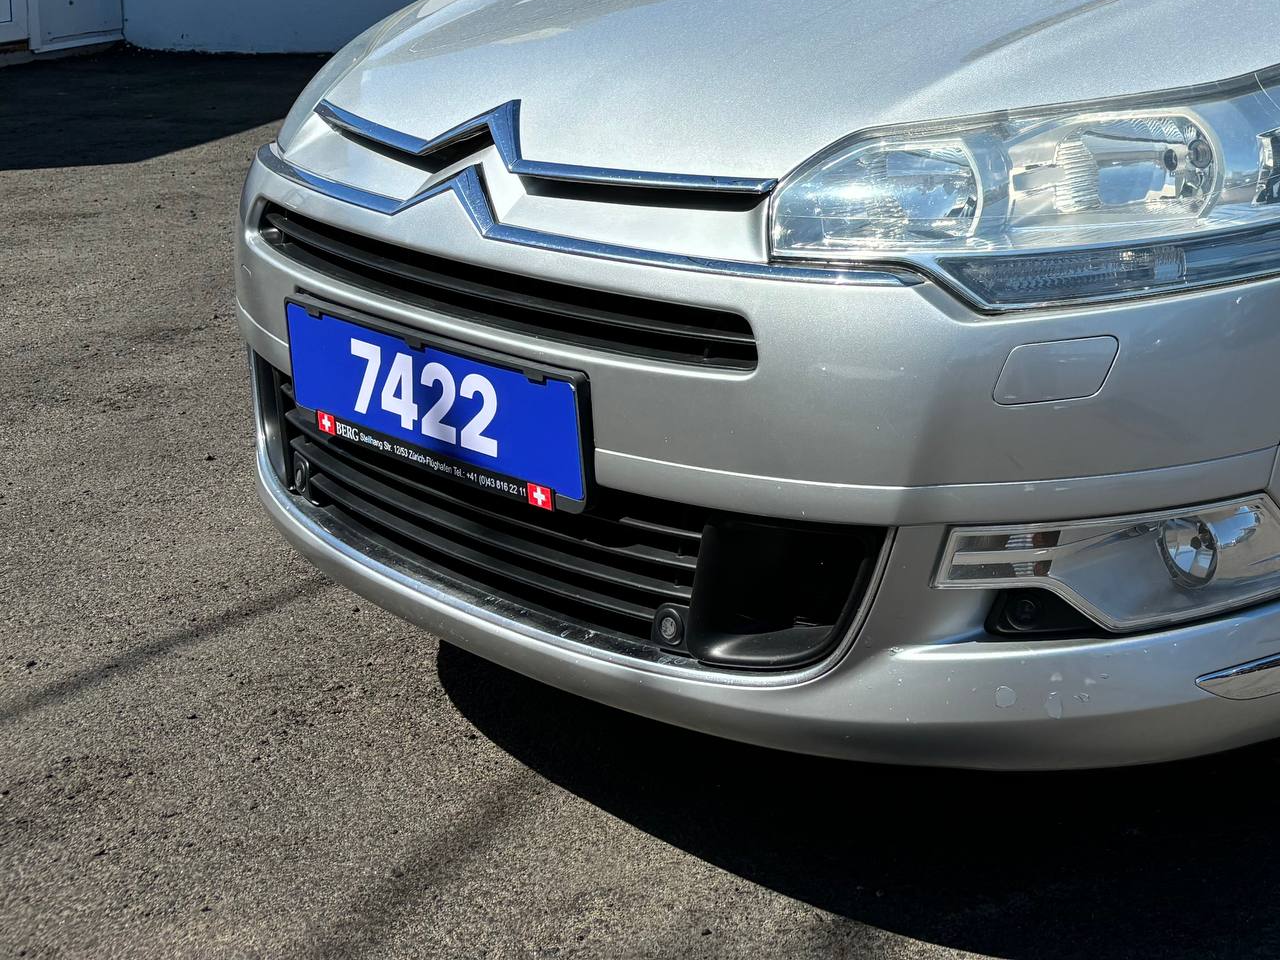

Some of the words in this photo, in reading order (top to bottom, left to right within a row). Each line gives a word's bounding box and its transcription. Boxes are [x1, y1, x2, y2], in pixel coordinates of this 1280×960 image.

[350, 337, 498, 458] 7422
[335, 421, 360, 442] BERG
[466, 472, 478, 482] +41
[496, 479, 509, 492] 816
[509, 483, 518, 495] 22
[519, 486, 527, 497] 11
